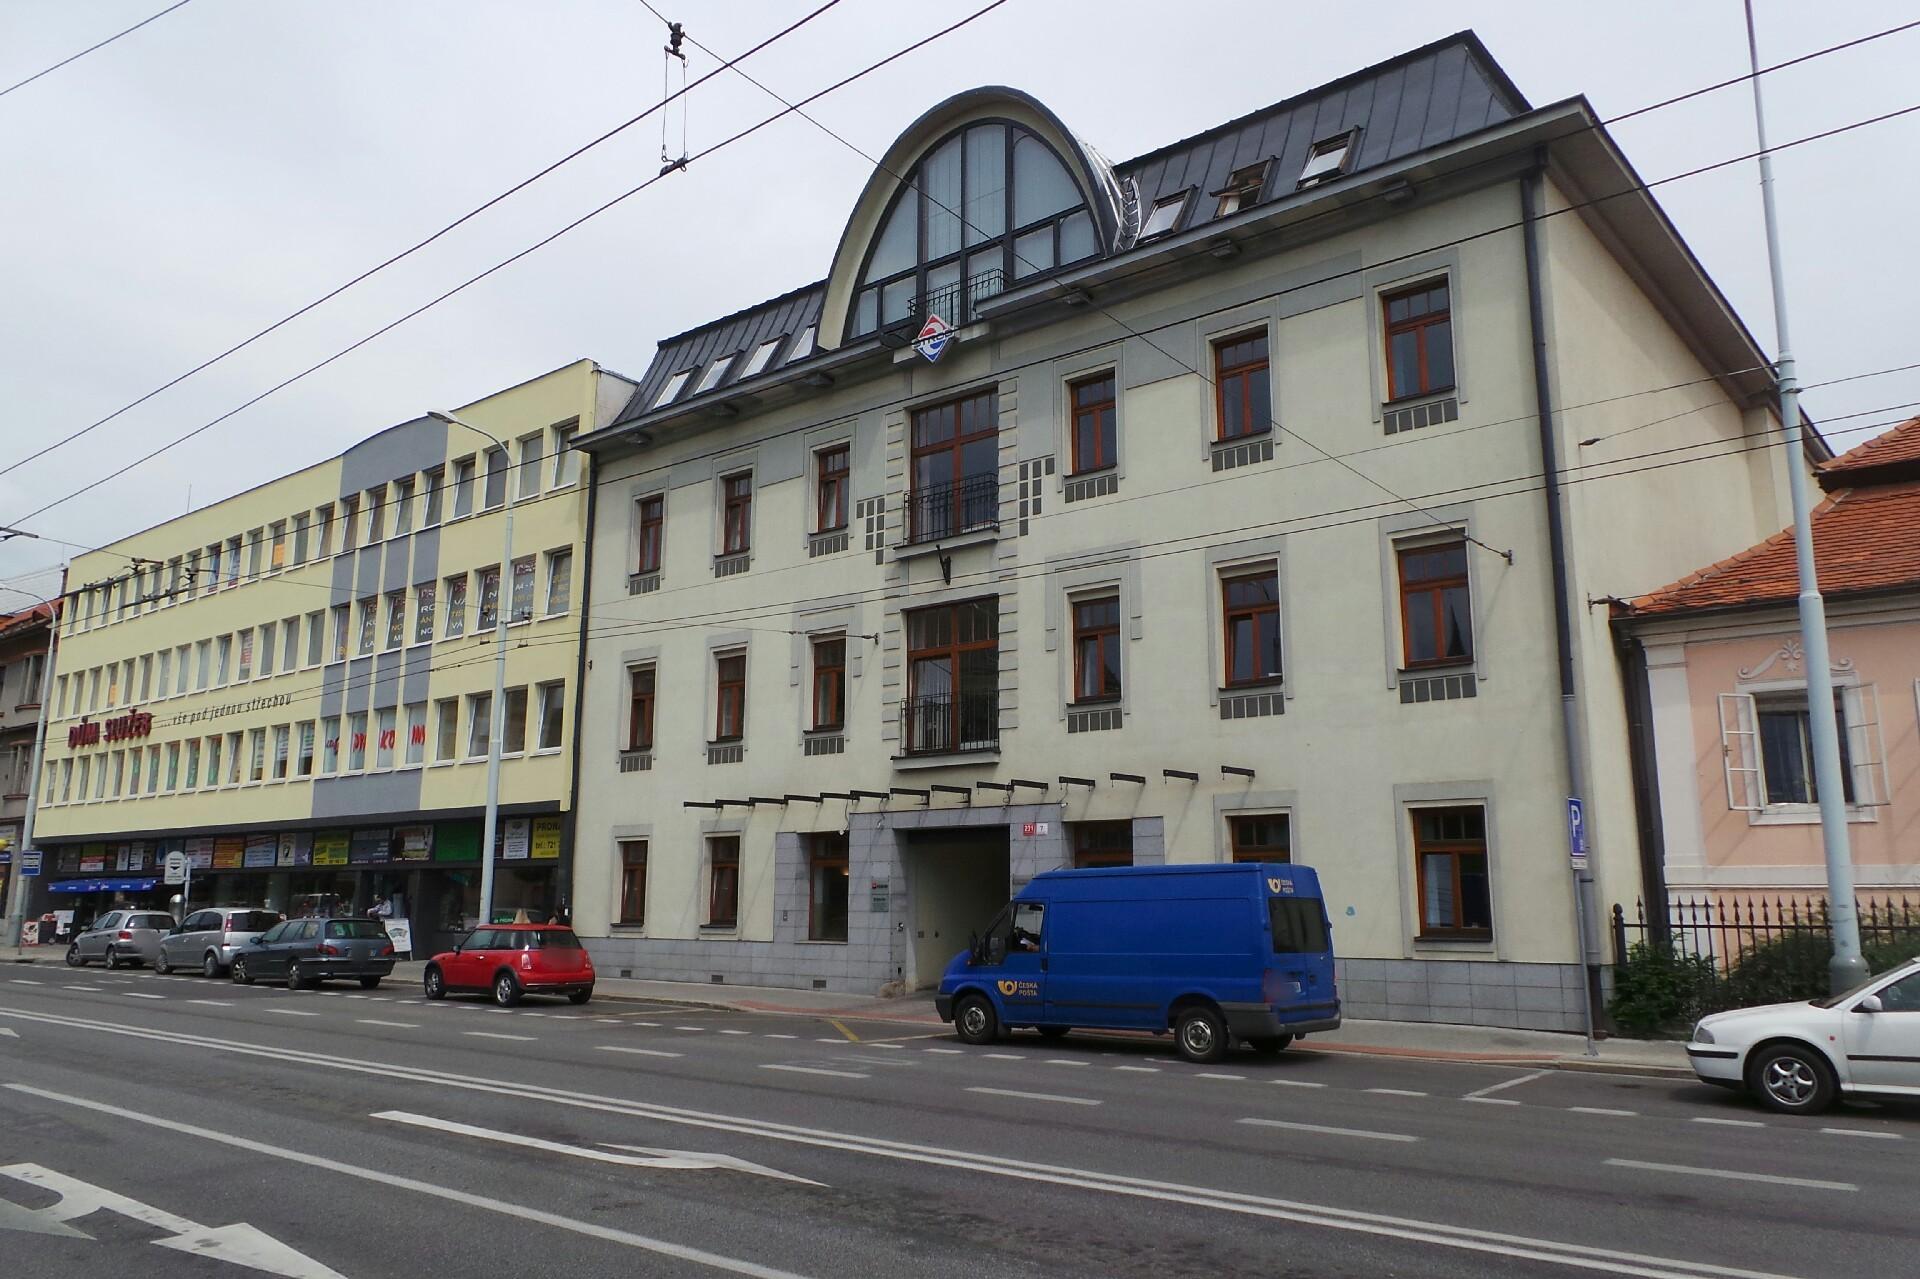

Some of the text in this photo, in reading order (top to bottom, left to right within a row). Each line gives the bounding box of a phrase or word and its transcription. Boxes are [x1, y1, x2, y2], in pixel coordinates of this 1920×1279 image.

[190, 707, 207, 725] pod
[209, 703, 242, 722] jednou
[246, 692, 292, 713] střechou
[68, 707, 153, 750] DŮM SLUŽEB
[1571, 805, 1581, 837] P
